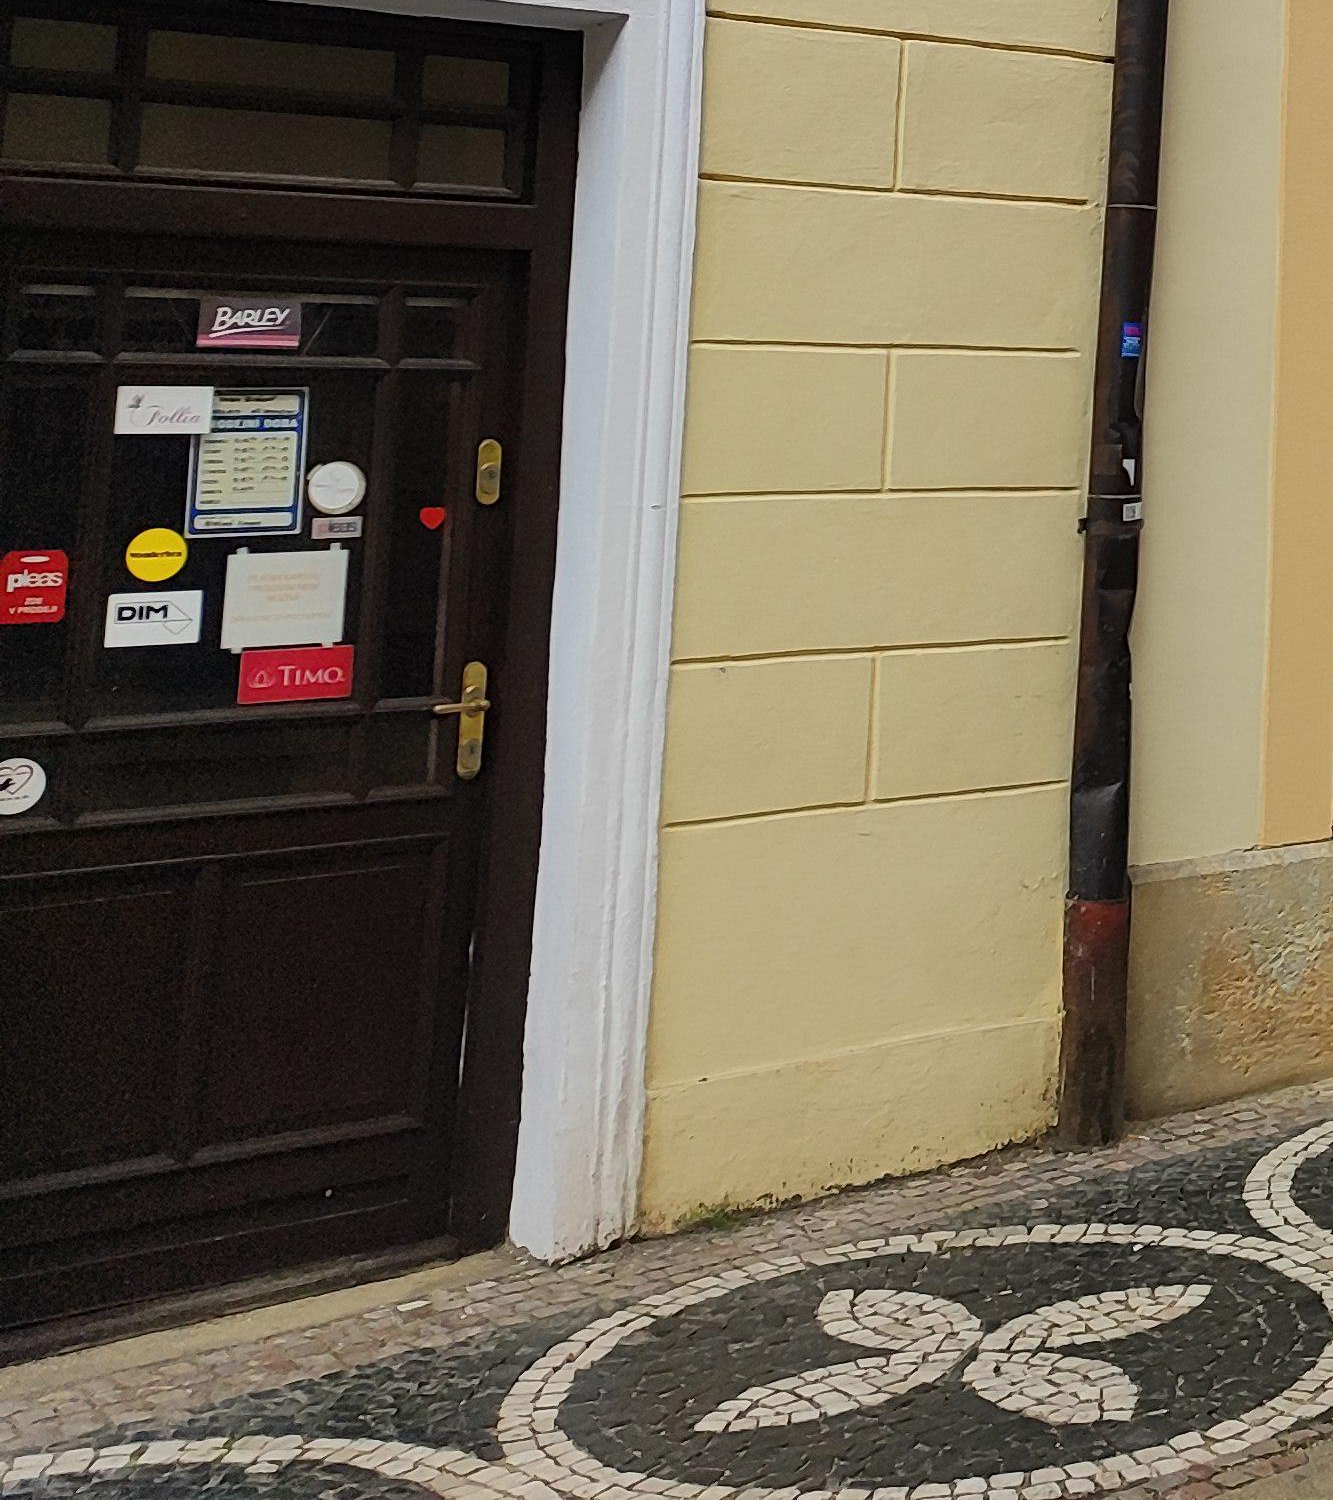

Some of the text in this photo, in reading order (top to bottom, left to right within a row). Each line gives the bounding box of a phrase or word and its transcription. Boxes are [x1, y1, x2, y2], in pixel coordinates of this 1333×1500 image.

[211, 306, 291, 331] BARLEY
[6, 568, 64, 593] pleas
[116, 604, 168, 622] DIM
